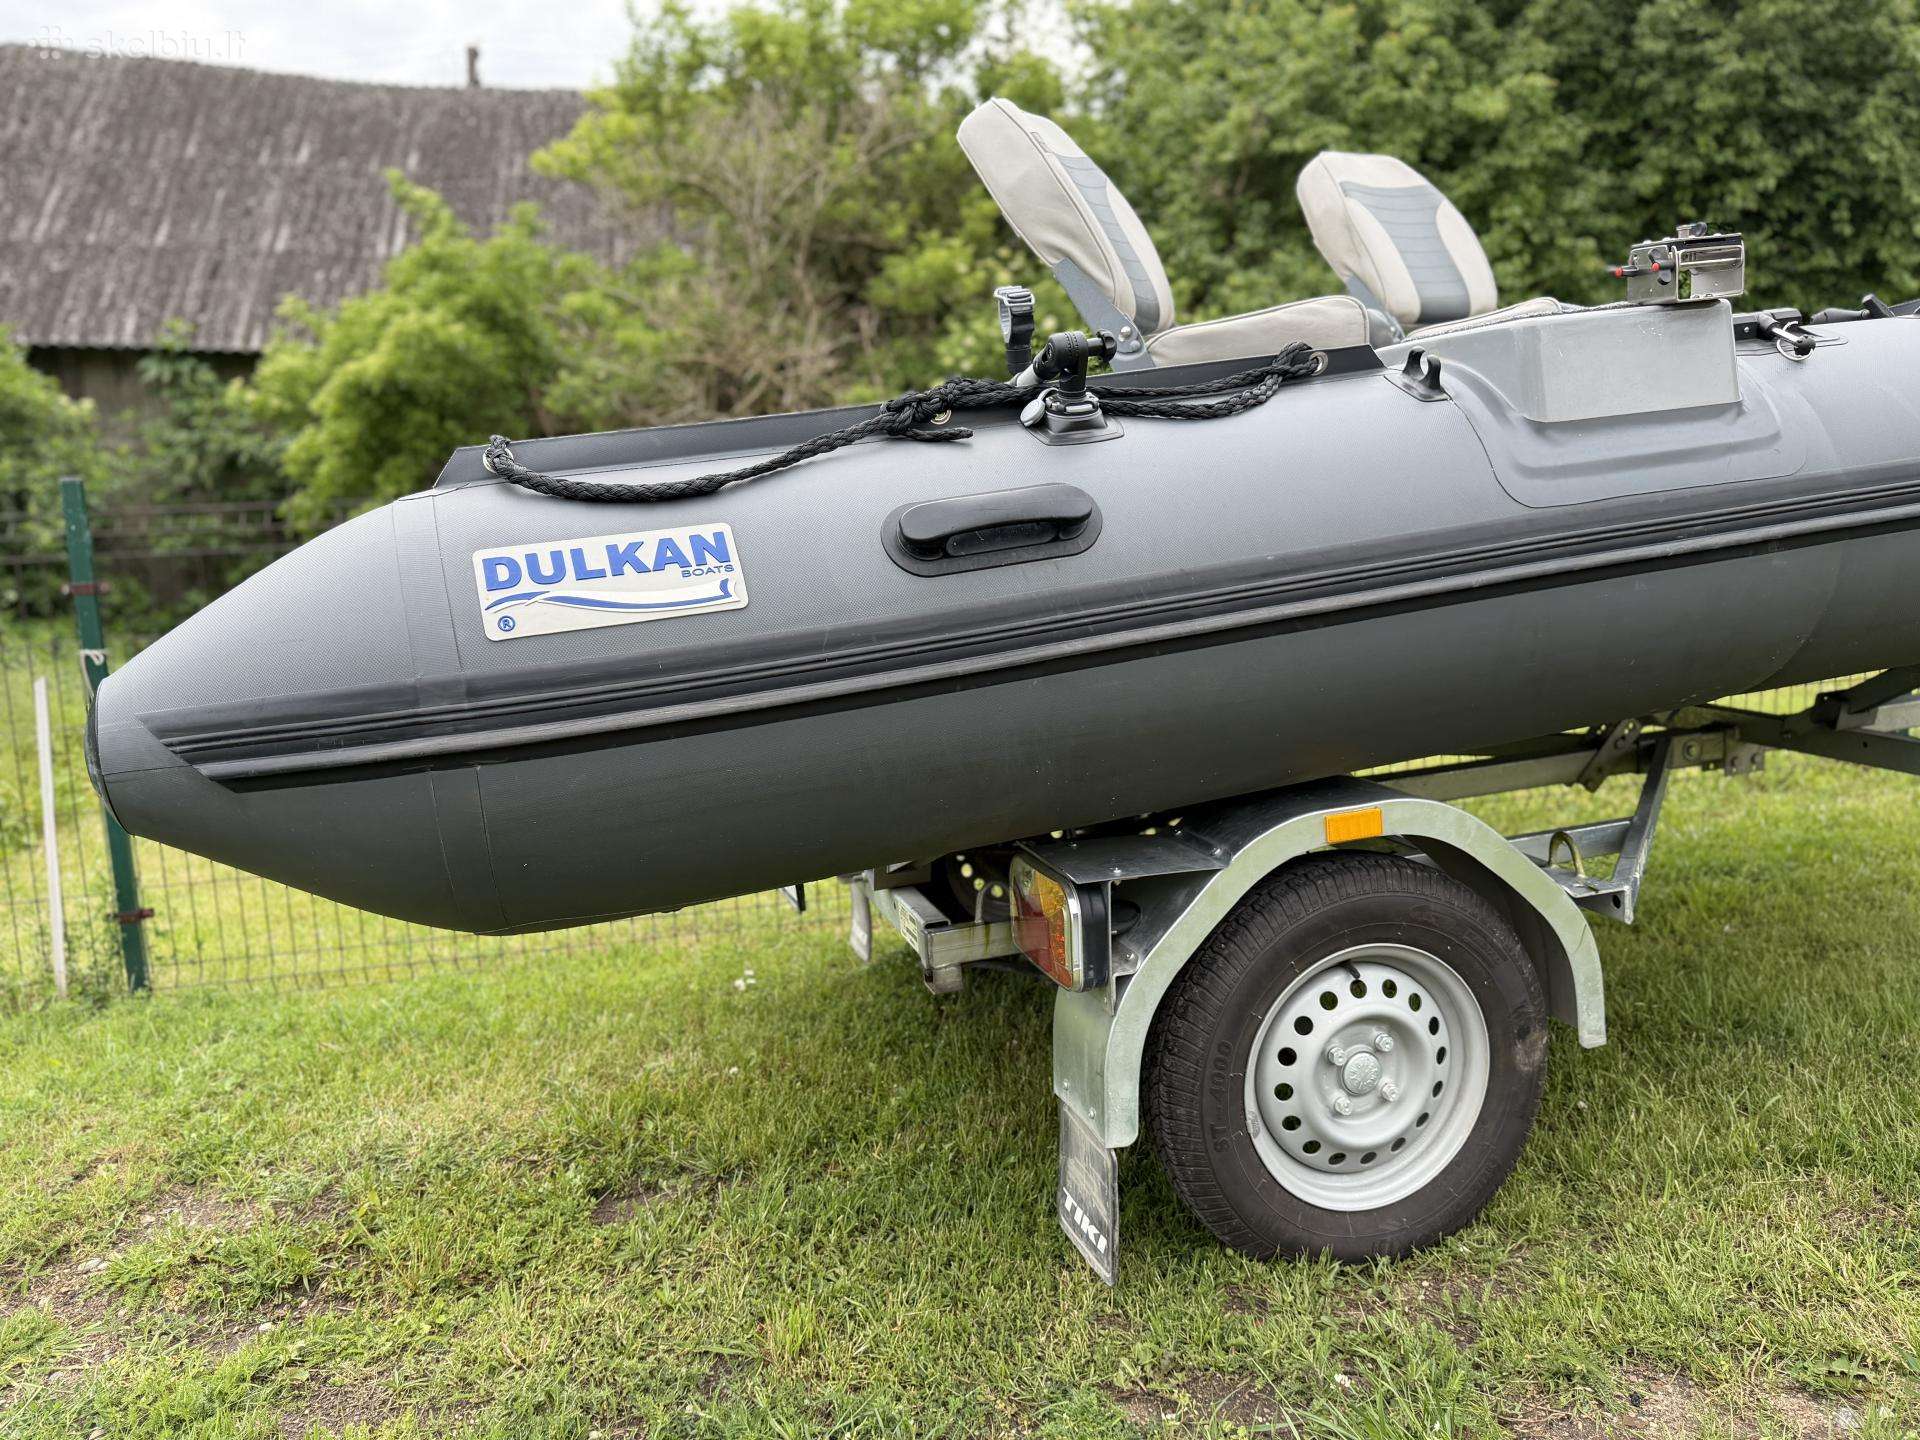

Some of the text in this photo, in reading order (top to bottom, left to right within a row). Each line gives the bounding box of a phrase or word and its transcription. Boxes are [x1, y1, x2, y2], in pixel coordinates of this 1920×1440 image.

[482, 531, 731, 592] DULKAN
[681, 564, 735, 578] BOATS
[1062, 1186, 1108, 1255] TIKI
